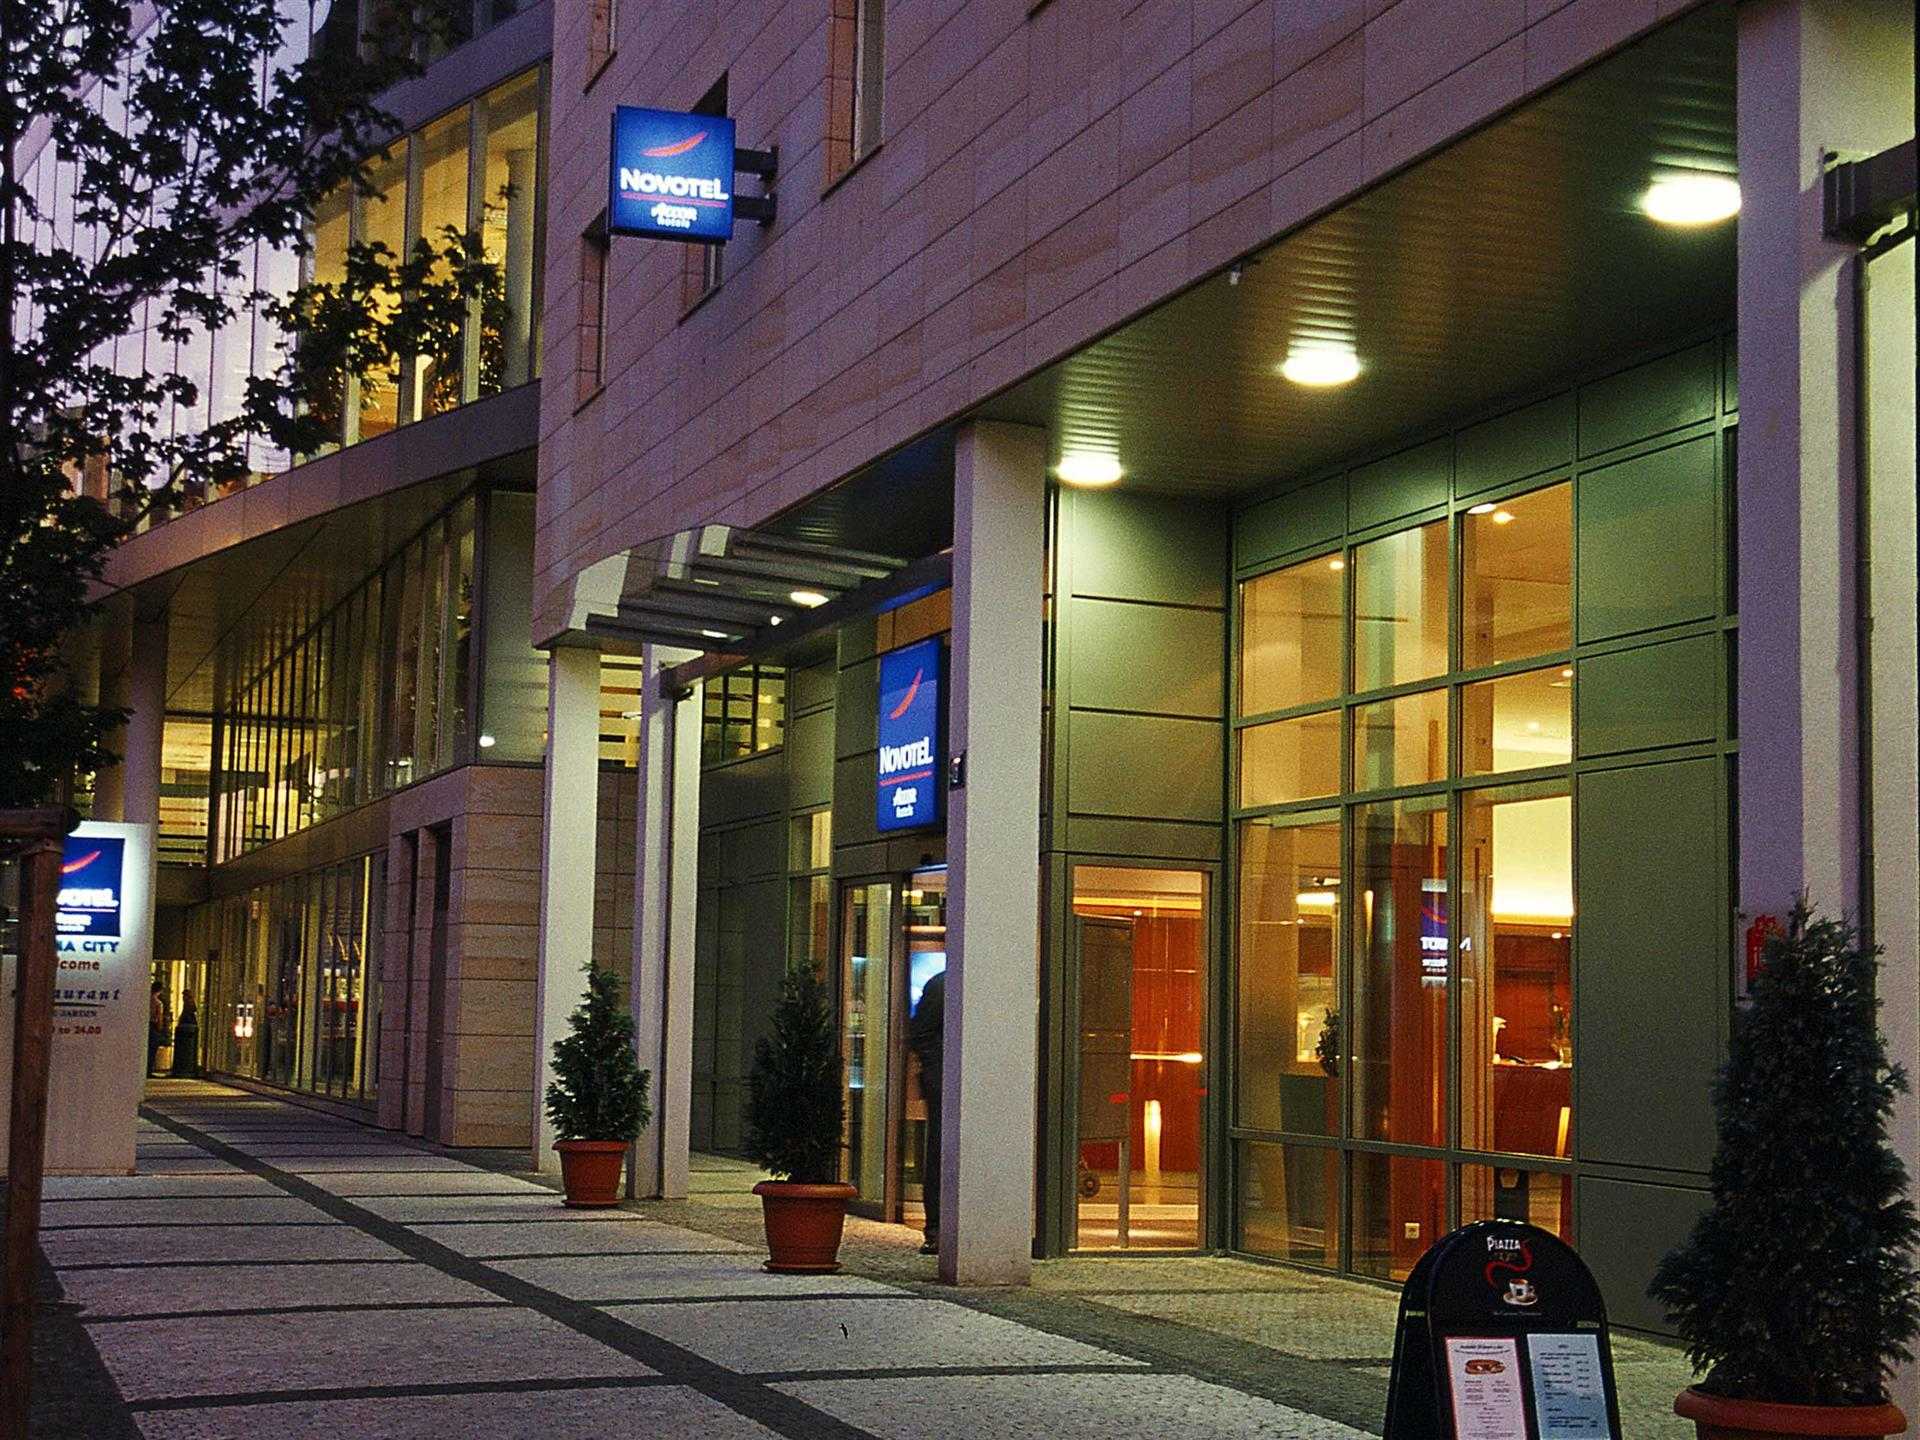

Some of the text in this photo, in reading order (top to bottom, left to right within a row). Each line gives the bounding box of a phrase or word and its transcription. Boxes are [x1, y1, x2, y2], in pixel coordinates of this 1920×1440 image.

[620, 168, 729, 200] NOVOTEL
[880, 736, 934, 774] NOVOTEL
[83, 941, 119, 952] CITY
[60, 959, 100, 971] come
[1487, 1236, 1521, 1251] PIAZZA
